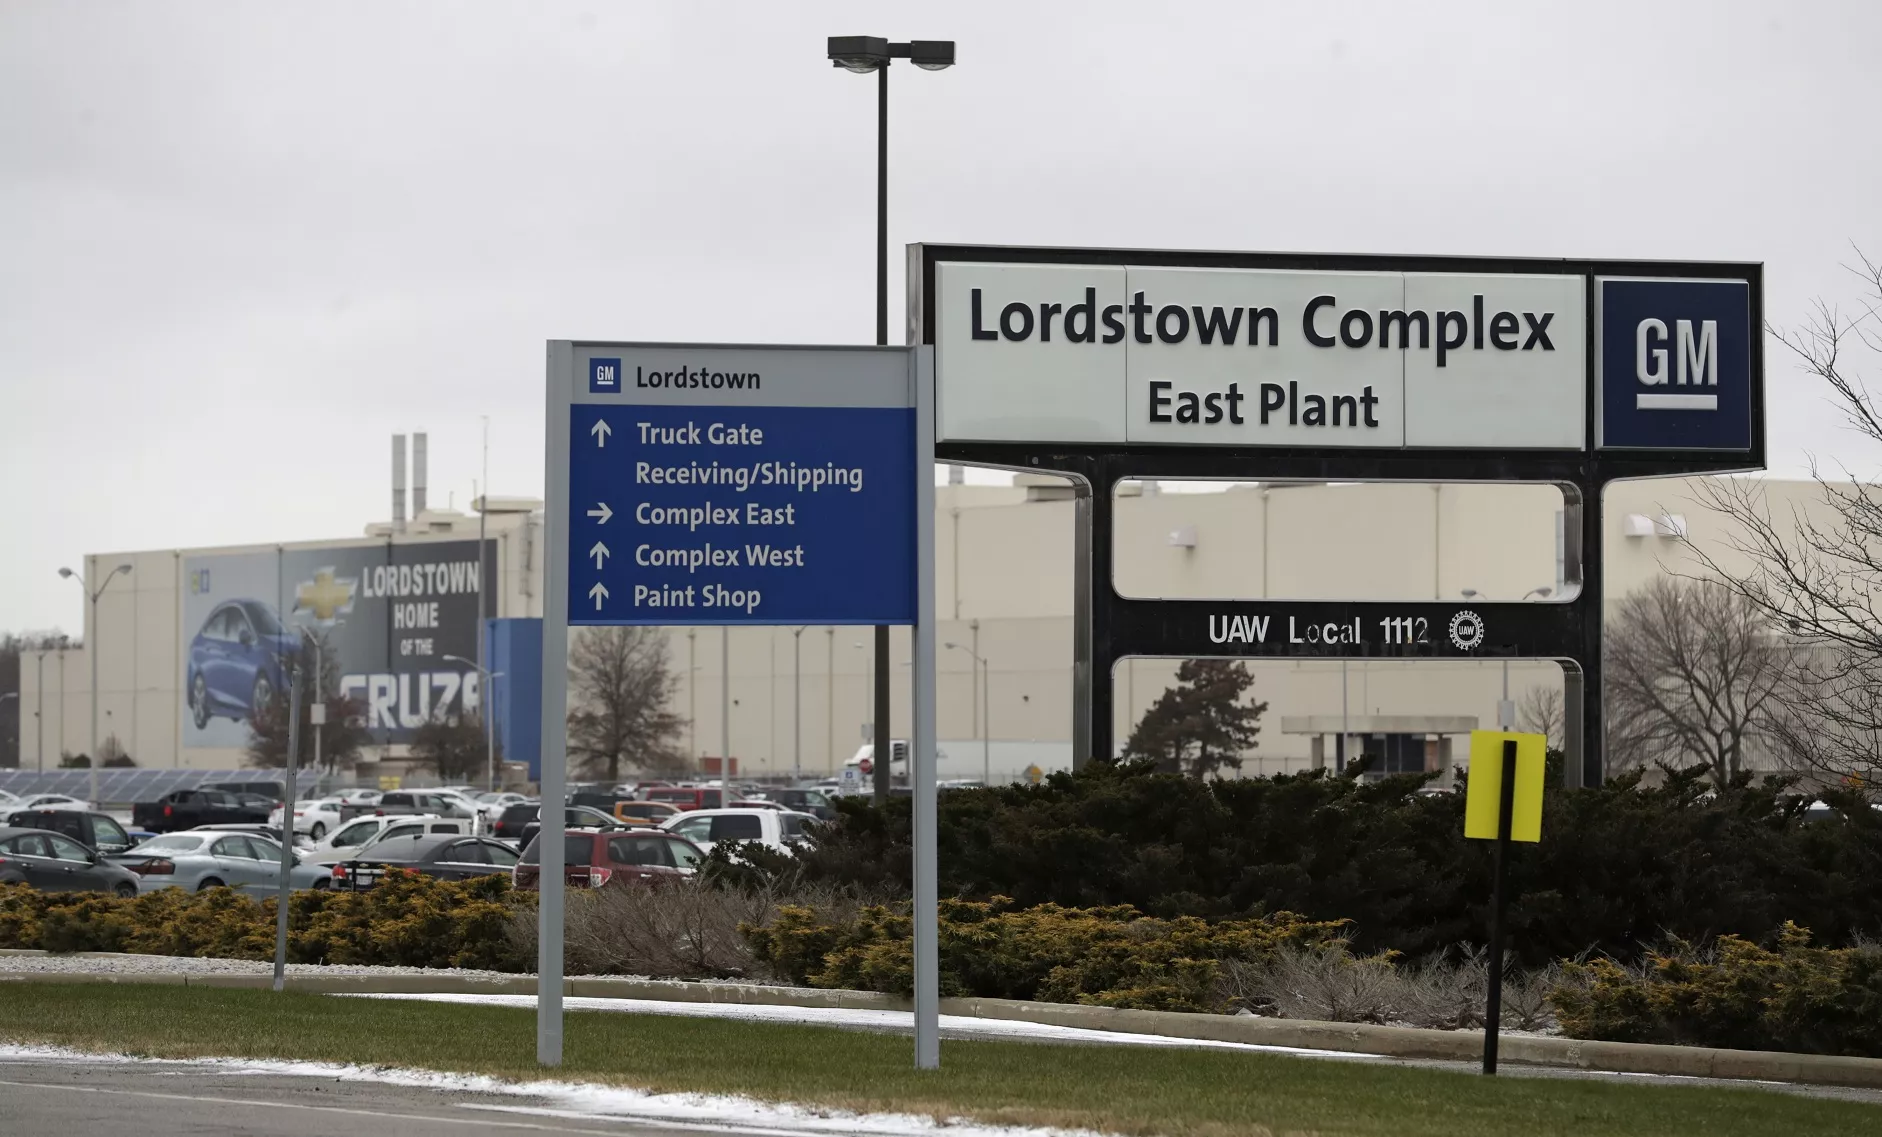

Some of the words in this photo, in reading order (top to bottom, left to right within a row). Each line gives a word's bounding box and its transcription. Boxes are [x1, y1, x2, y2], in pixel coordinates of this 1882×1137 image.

[972, 286, 1279, 345] Lordstown
[1302, 294, 1556, 367] Complex
[1636, 317, 1718, 386] GM
[596, 365, 614, 381] GM
[636, 365, 761, 390] Lordstown
[1149, 380, 1244, 425] East
[1260, 380, 1379, 428] Plant
[637, 421, 702, 445] Truck
[707, 422, 763, 445] Gate
[635, 460, 863, 493] Receiving/Shipping
[635, 502, 740, 532] Complex
[746, 503, 795, 525] East
[635, 543, 740, 573] Complex
[745, 544, 804, 567] West
[362, 561, 480, 598] LORDSTOWN
[634, 584, 696, 607] Paint
[702, 584, 761, 615] Shop
[394, 602, 439, 629] HOME
[1209, 614, 1271, 644] UAW
[1289, 615, 1361, 645] Local
[1379, 616, 1429, 644] 1112
[1457, 625, 1475, 635] UAW
[400, 638, 414, 655] OF
[414, 637, 434, 655] THE
